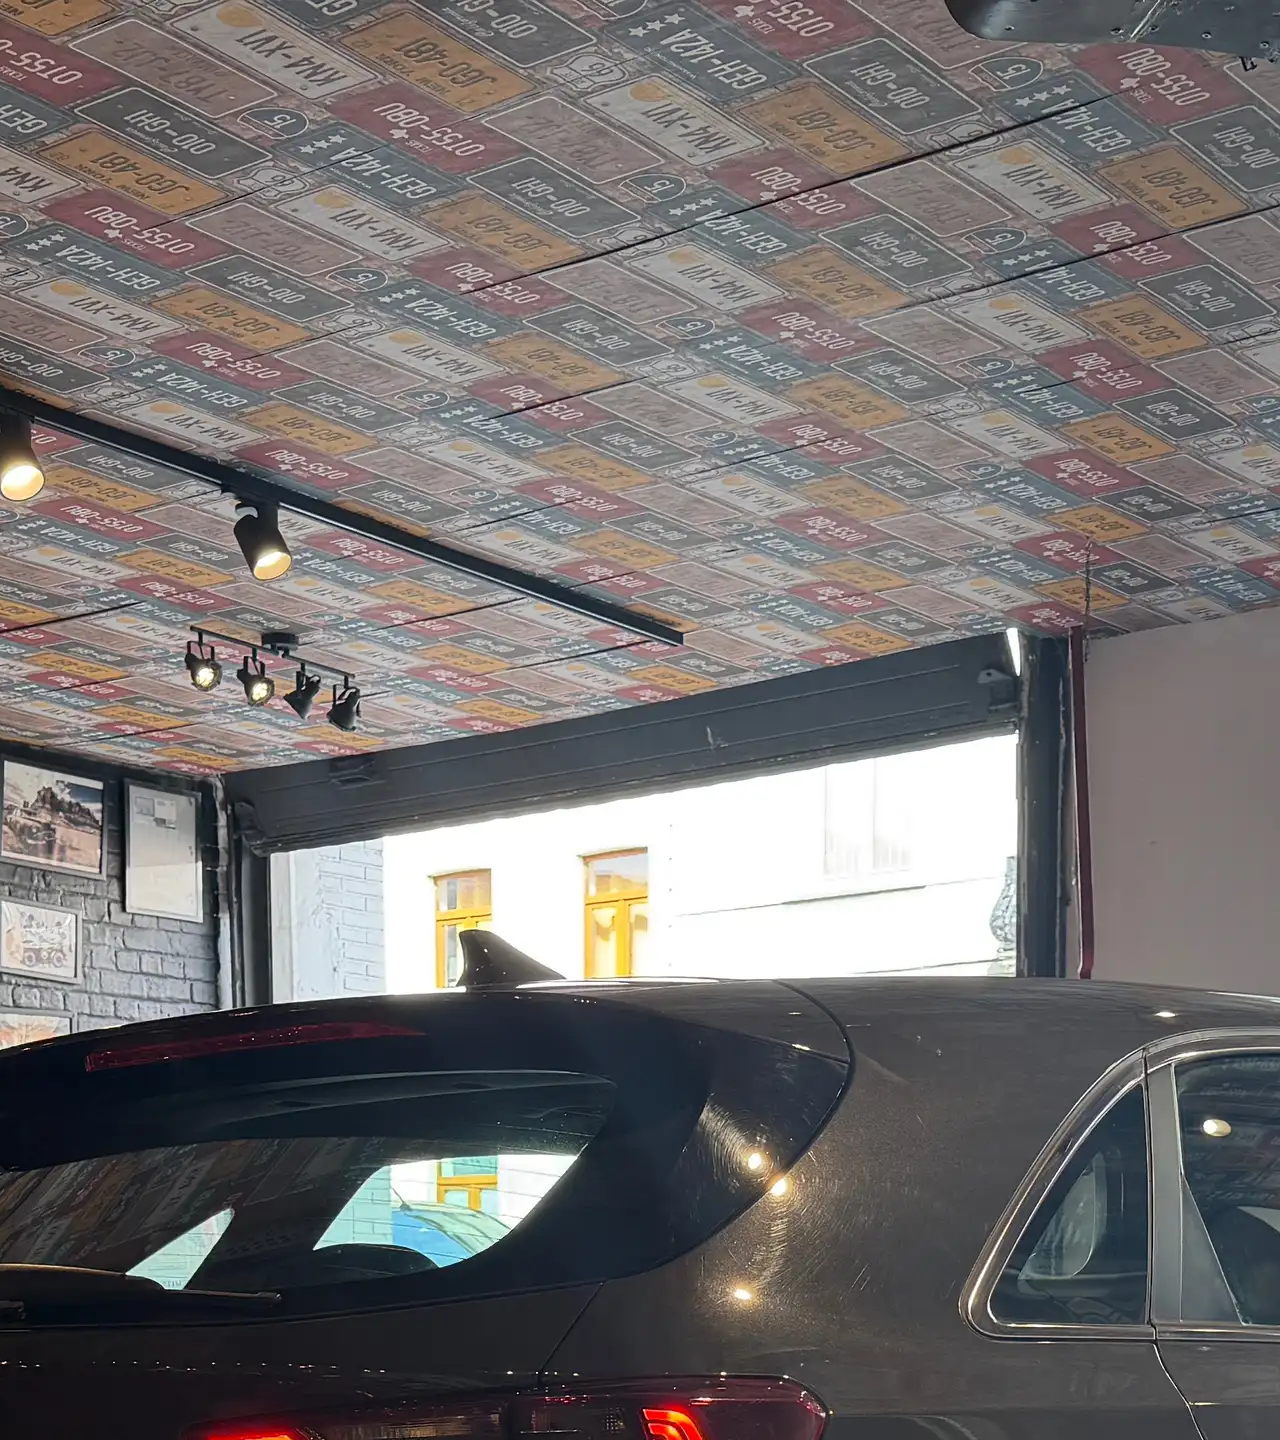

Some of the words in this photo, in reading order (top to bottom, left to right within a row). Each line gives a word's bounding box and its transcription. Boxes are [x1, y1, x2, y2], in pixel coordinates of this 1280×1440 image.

[660, 27, 765, 90] GEH-142A
[995, 62, 1030, 80] 15
[264, 113, 296, 129] 15
[330, 146, 435, 199] GEH-142A
[643, 178, 674, 193] 15
[984, 232, 1015, 245] 15
[56, 244, 159, 289] GEH-142A
[349, 271, 377, 284] 15
[405, 296, 495, 337] GEH-142A
[99, 349, 125, 360] 15
[722, 343, 802, 381] GEH-142A
[157, 372, 247, 407] GEH-142A
